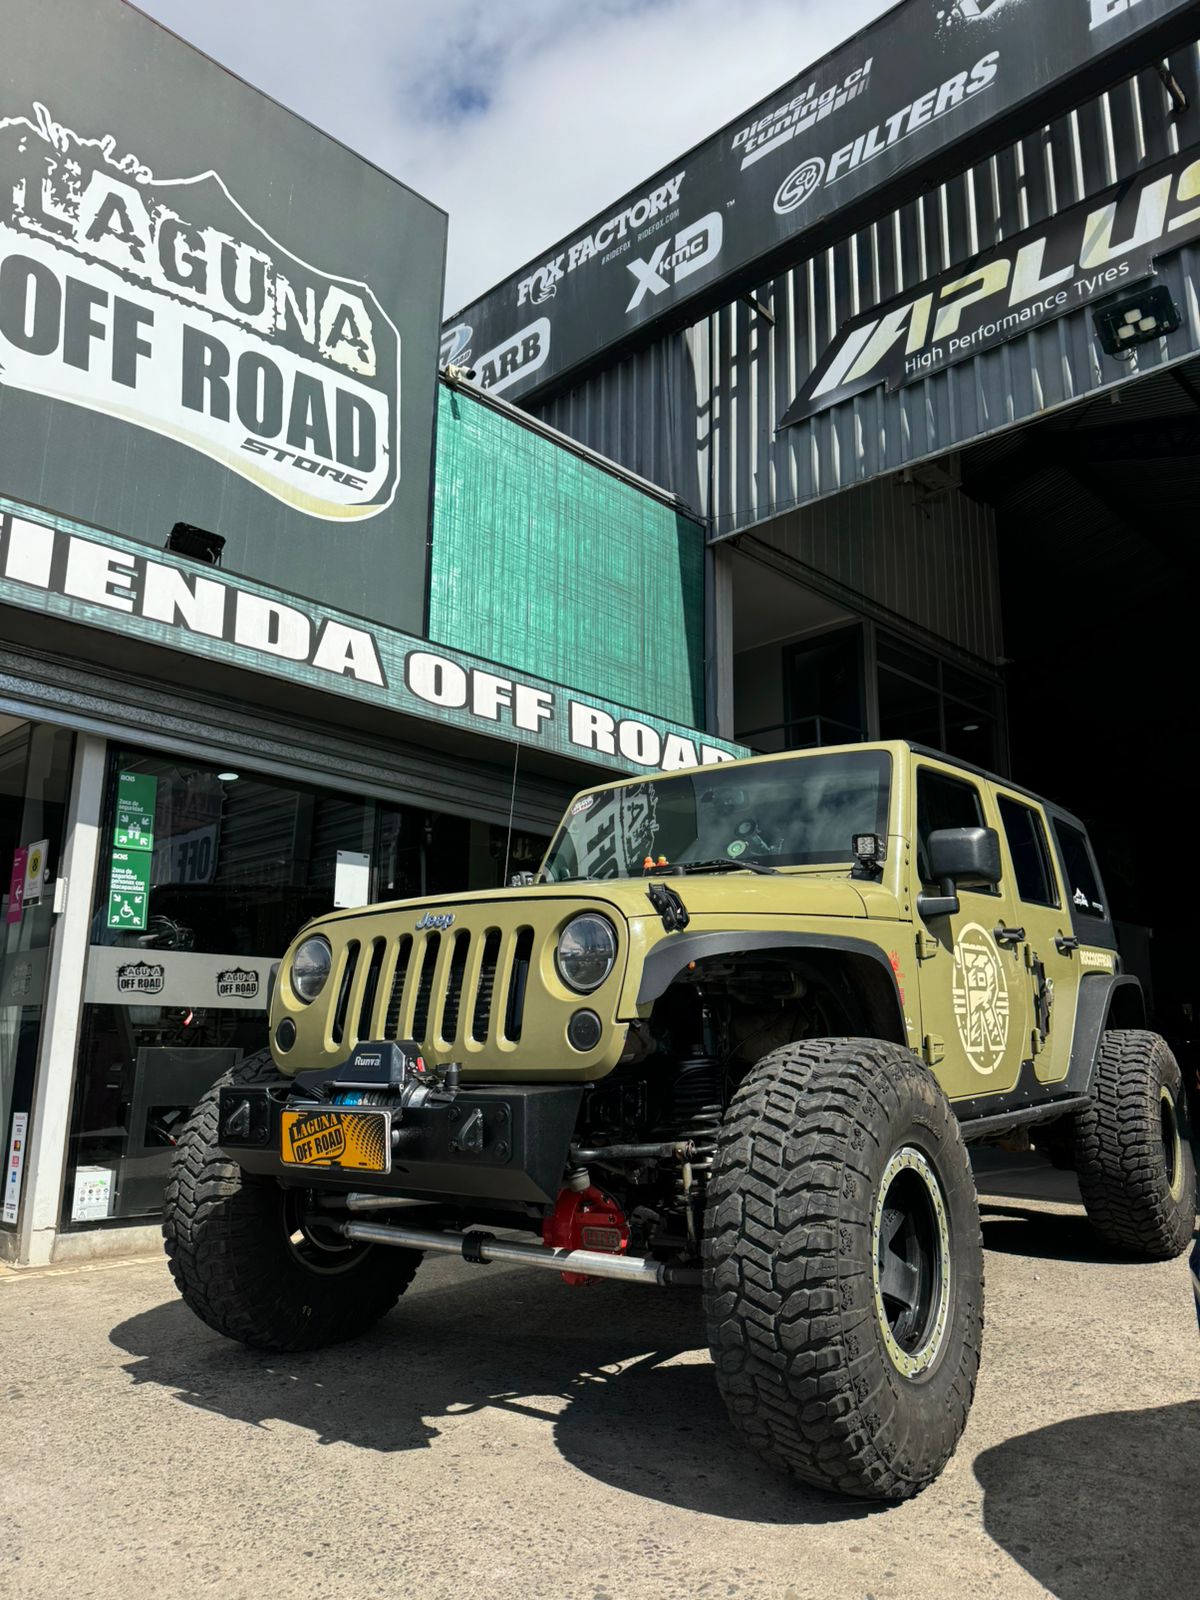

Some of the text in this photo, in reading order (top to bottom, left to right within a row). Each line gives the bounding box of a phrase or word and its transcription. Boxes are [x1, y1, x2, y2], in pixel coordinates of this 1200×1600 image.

[731, 82, 816, 150] Diesel
[744, 57, 873, 153] tuning.cl
[826, 50, 1000, 183] FILTERS
[517, 170, 686, 306] FOX FACTORY
[601, 208, 680, 265] #RIDEFOX RIDEFOX.COM
[13, 165, 377, 376] LAGUNA
[905, 262, 1130, 374] High Performance Tyres
[0, 254, 376, 473] OFF ROAD
[480, 331, 541, 390] ARB
[241, 437, 367, 491] STORE
[0, 512, 389, 688] IENDA
[406, 652, 555, 734] OFF
[415, 911, 456, 931] Jeep
[121, 978, 161, 989] OFF ROAD
[220, 982, 257, 994] OFF ROAD
[354, 1056, 381, 1066] Runva
[293, 1113, 338, 1139] LAGUNA
[296, 1128, 342, 1161] OFF ROAD
